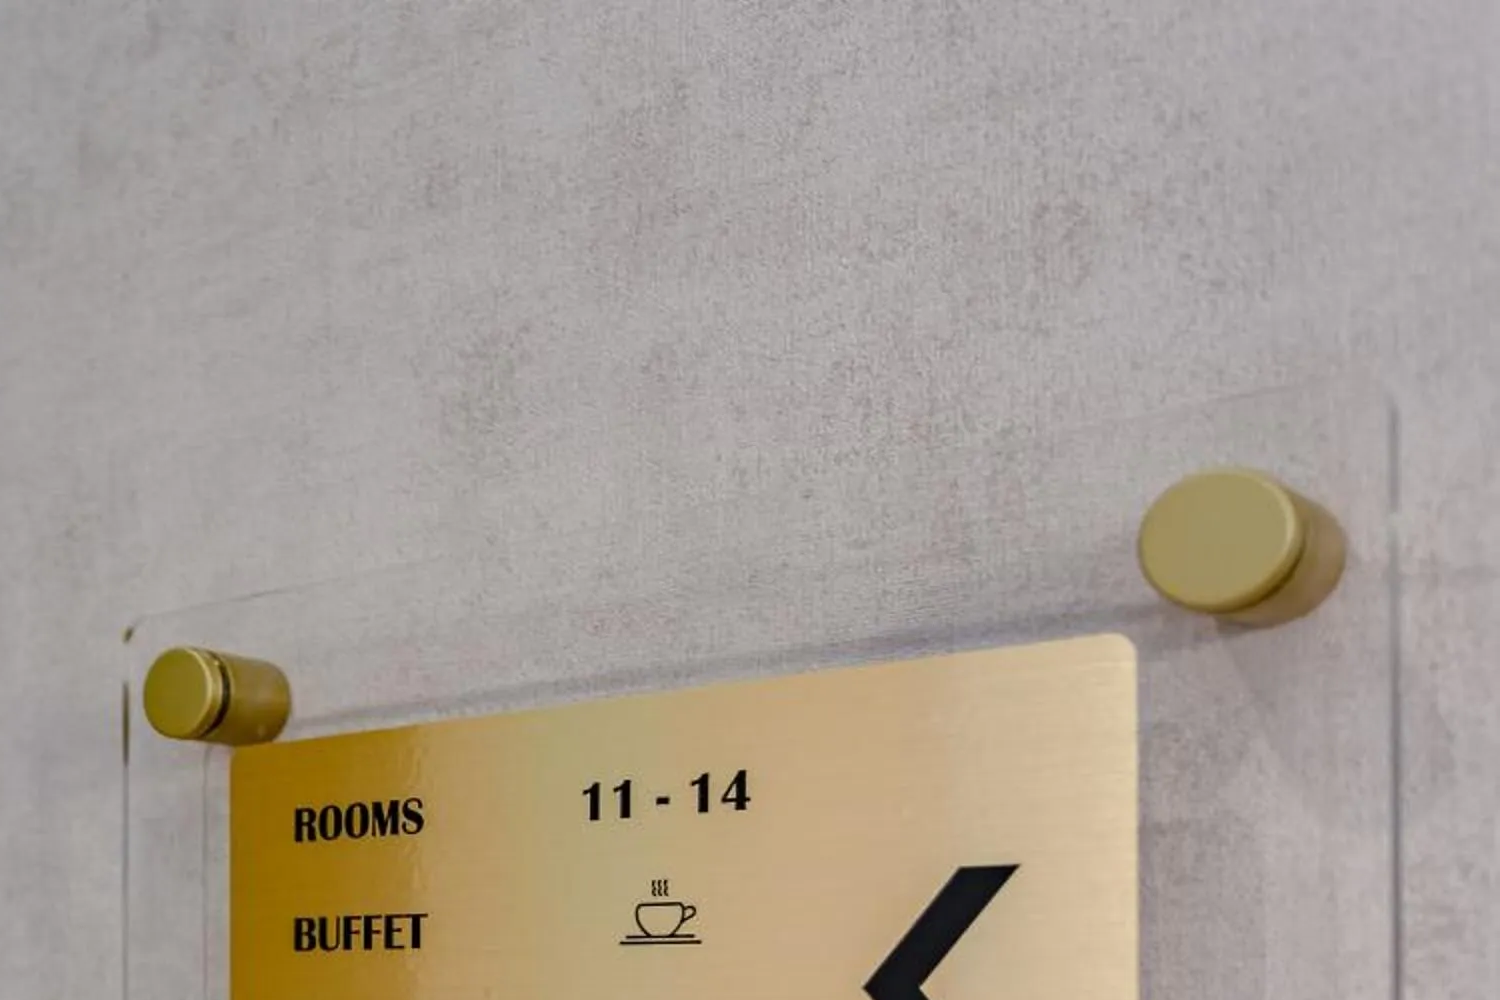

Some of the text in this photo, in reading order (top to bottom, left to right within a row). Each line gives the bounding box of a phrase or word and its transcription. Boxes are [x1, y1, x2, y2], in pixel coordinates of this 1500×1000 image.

[292, 797, 426, 844] ROOMS
[581, 779, 633, 822] 11
[690, 768, 752, 814] 14
[292, 912, 429, 953] BUFFET
